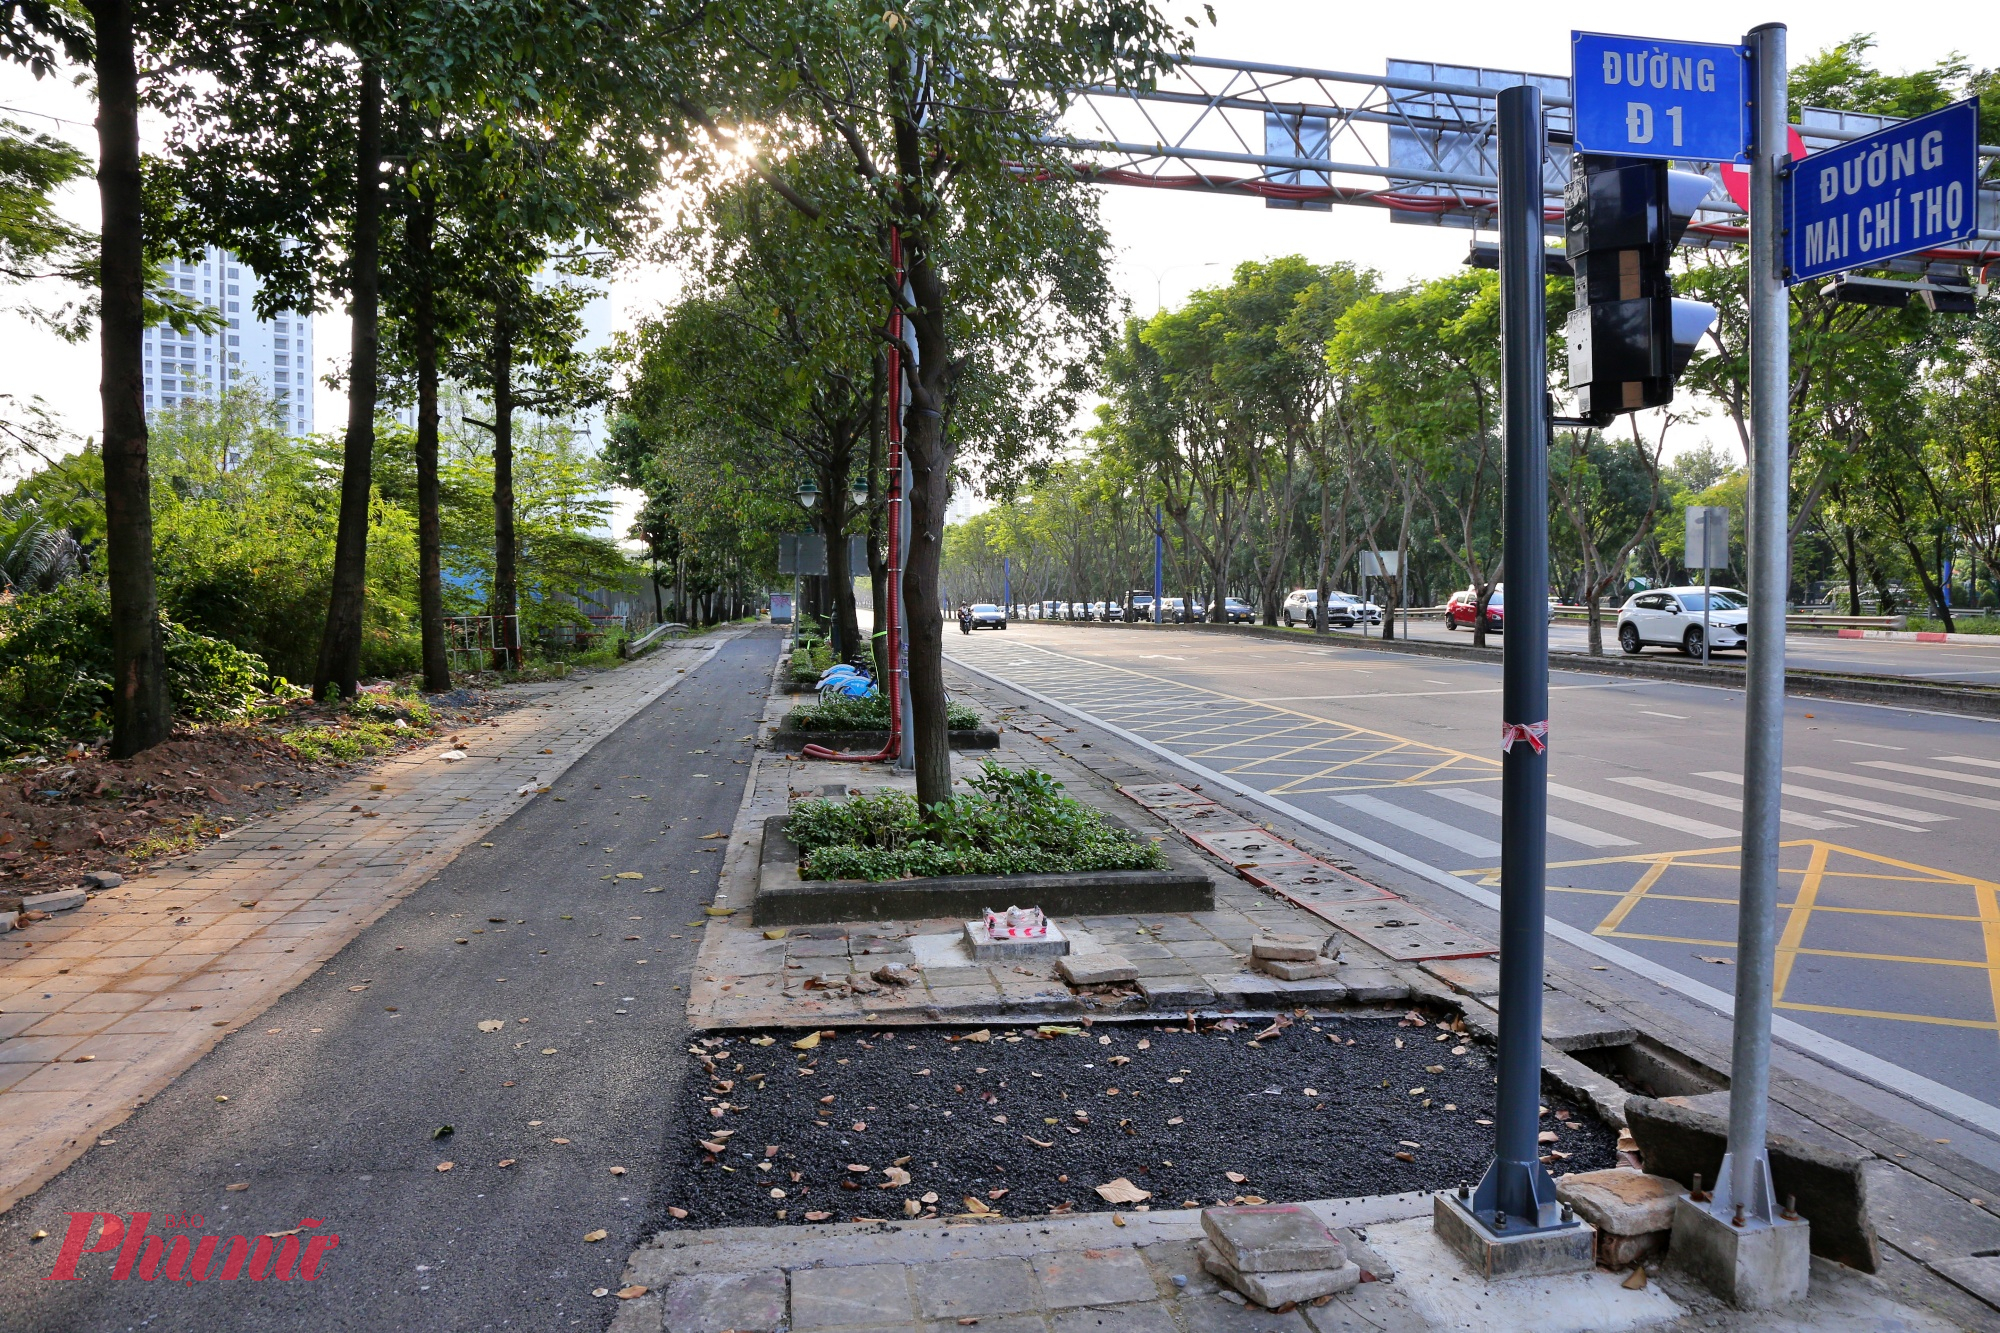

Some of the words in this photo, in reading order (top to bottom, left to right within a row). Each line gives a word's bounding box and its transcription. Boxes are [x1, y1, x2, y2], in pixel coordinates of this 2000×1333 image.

[1602, 46, 1716, 92] ĐƯỜNG
[1819, 130, 1944, 204] ĐƯỜNG
[1804, 213, 1849, 268] MAI
[1858, 188, 1902, 253] CHÍ
[1910, 180, 1963, 239] THỌ
